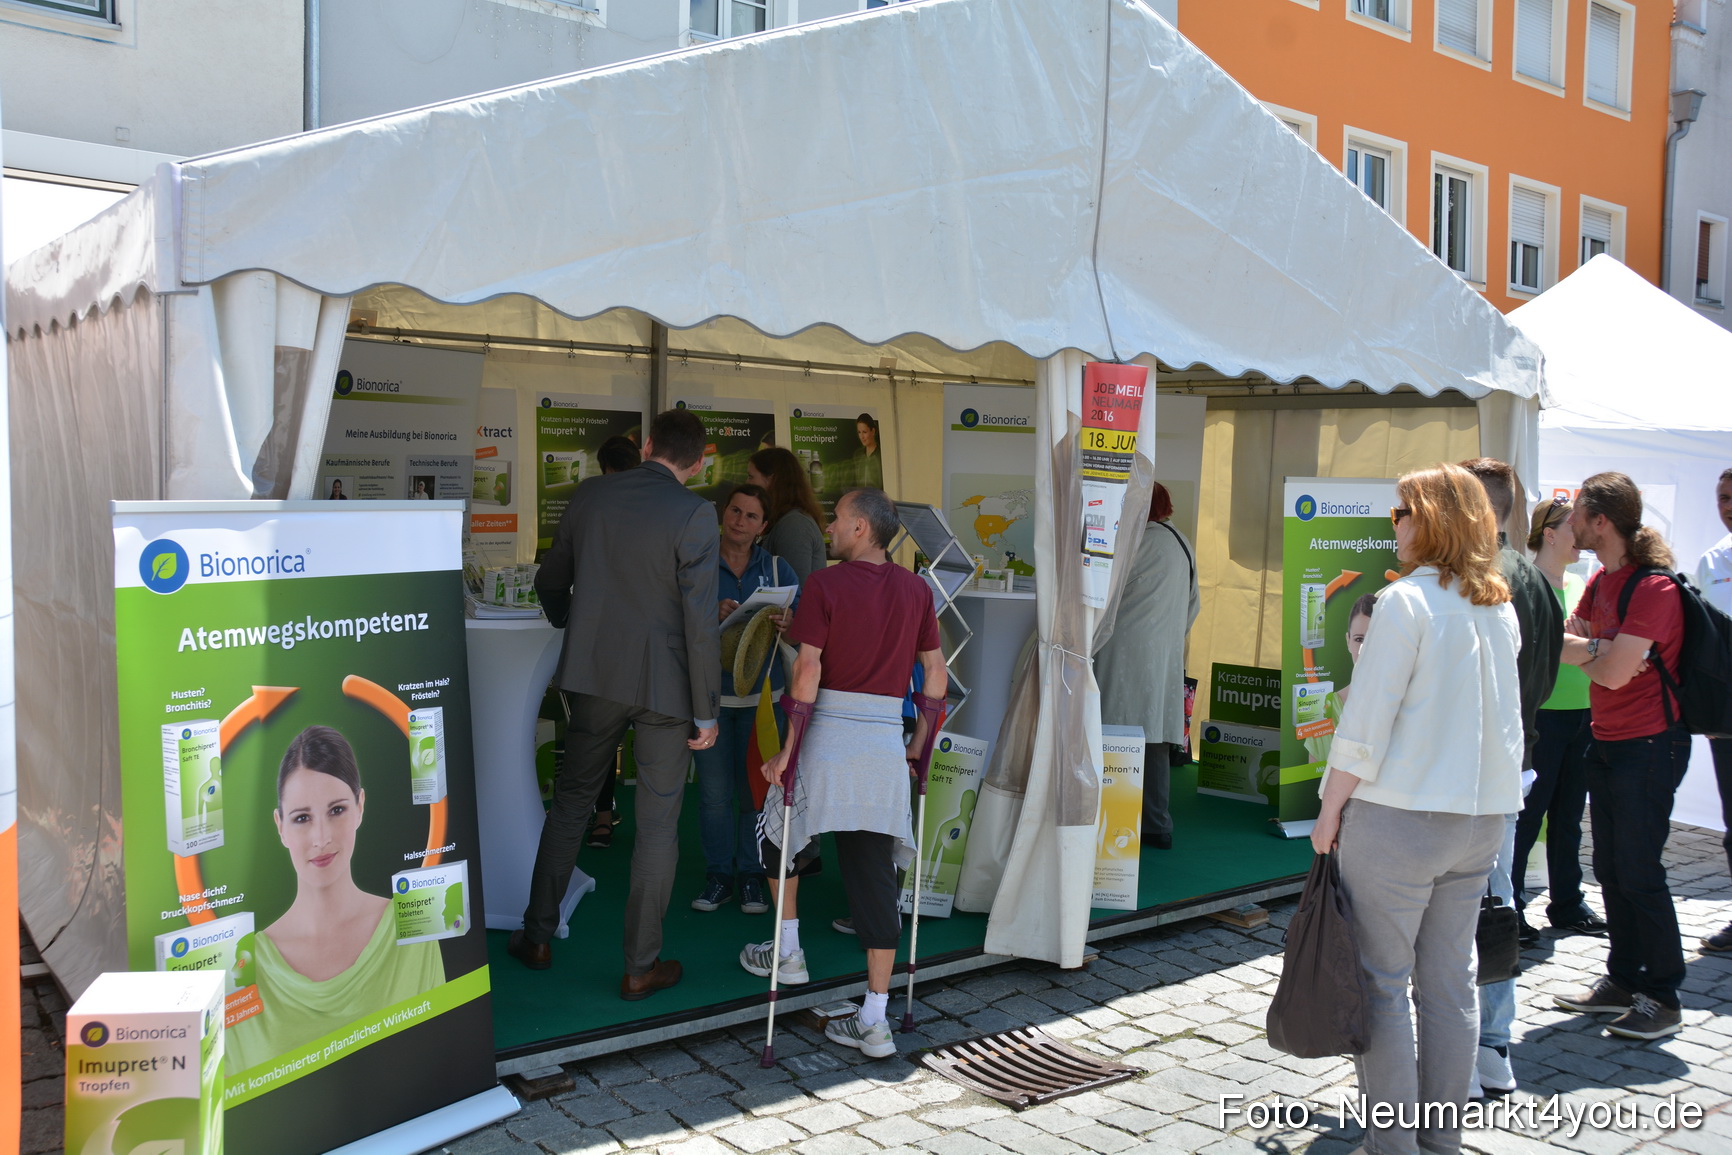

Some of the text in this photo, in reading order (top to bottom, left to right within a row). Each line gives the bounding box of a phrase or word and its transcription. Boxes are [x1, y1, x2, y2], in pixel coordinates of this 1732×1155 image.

[357, 378, 400, 393] Bionorica
[982, 414, 1028, 426] Bionorica
[1091, 409, 1114, 422] 2016
[345, 429, 457, 442] Meine Ausbildung bei Bionorica
[1089, 432, 1108, 449] 18.
[326, 459, 391, 467] Kaufmännische Berufe
[409, 459, 459, 468] Technische Berufe
[1320, 502, 1371, 515] Bionorica
[177, 611, 430, 652] Atemwegskompetenz
[398, 677, 450, 692] Kratzen im Hals?
[1218, 671, 1262, 687] Kratzen
[171, 687, 206, 700] Husten?
[411, 690, 441, 701] Frösteln?
[165, 699, 212, 713] Bronchitis?
[1223, 732, 1263, 747] Bionorica
[953, 742, 983, 757] Bionorica
[1102, 743, 1140, 753] Bionorica
[1240, 756, 1247, 764] N
[932, 773, 952, 785] Saft TE
[186, 841, 198, 849] 100
[404, 843, 456, 861] Halsschmerzen?
[412, 875, 446, 889] Bionorica
[178, 884, 227, 904] Nase dicht?
[160, 893, 244, 920] Druckkopfschmerz?
[398, 909, 424, 918] Tabletten
[193, 927, 235, 949] Bionorica
[226, 1004, 260, 1025] 12 Jahren
[116, 1025, 188, 1041] Bionorica
[225, 1001, 432, 1101] Mit kombinierter pflanzlicher Wirkkraft
[172, 1056, 186, 1070] N
[79, 1080, 130, 1093] Tropfen
